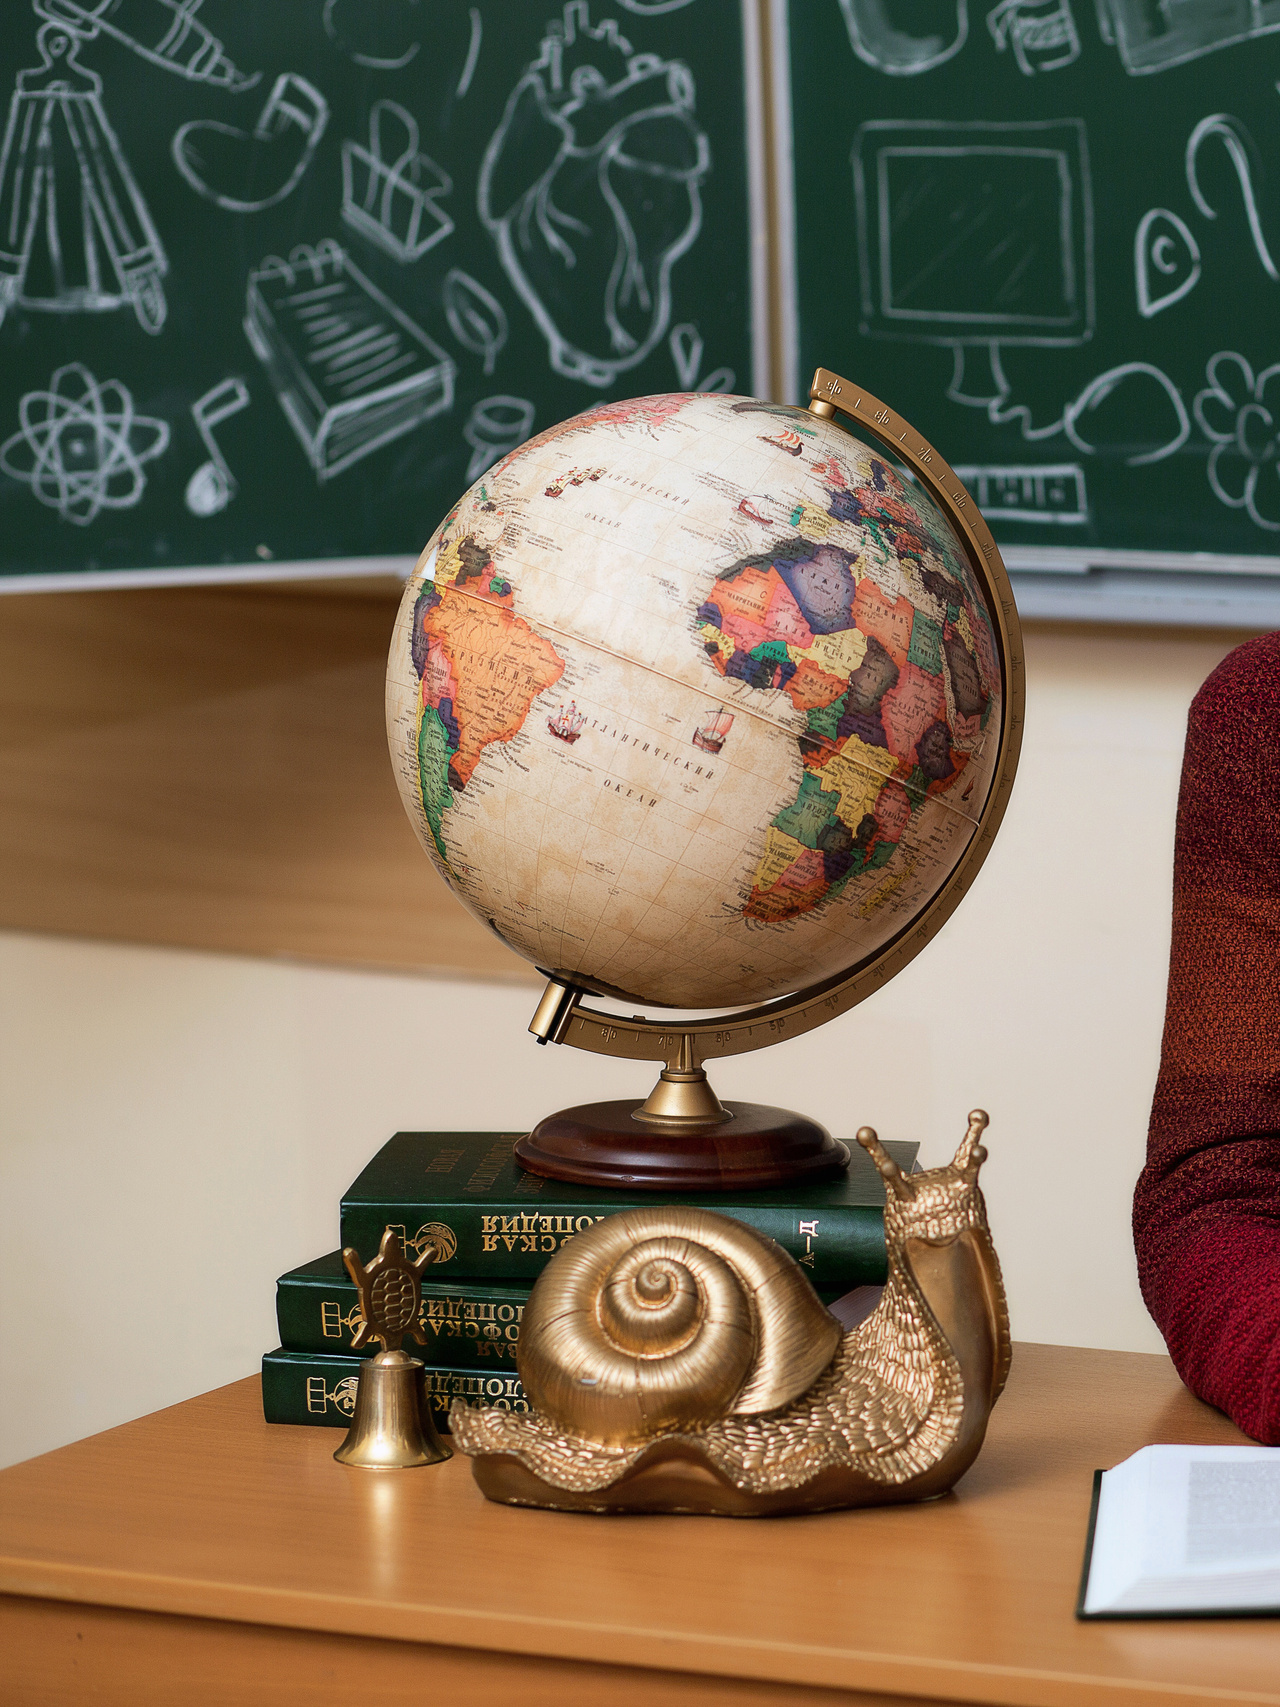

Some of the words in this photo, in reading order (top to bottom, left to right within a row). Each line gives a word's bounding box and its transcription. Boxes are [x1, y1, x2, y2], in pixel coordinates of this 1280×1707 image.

[584, 512, 623, 529] ОКЕАН
[770, 535, 799, 554] МАРОККО
[797, 565, 852, 597] АЛЖИР
[725, 588, 767, 614] МАВРИТАНИЯ
[772, 618, 808, 640] МАЛИ
[812, 639, 854, 664] НИГЕР
[448, 648, 534, 685] БРАЗИЛИЯ
[582, 716, 715, 780] АТЛАНТИЧЕСКИЙ
[603, 778, 658, 808] ОКЕАН
